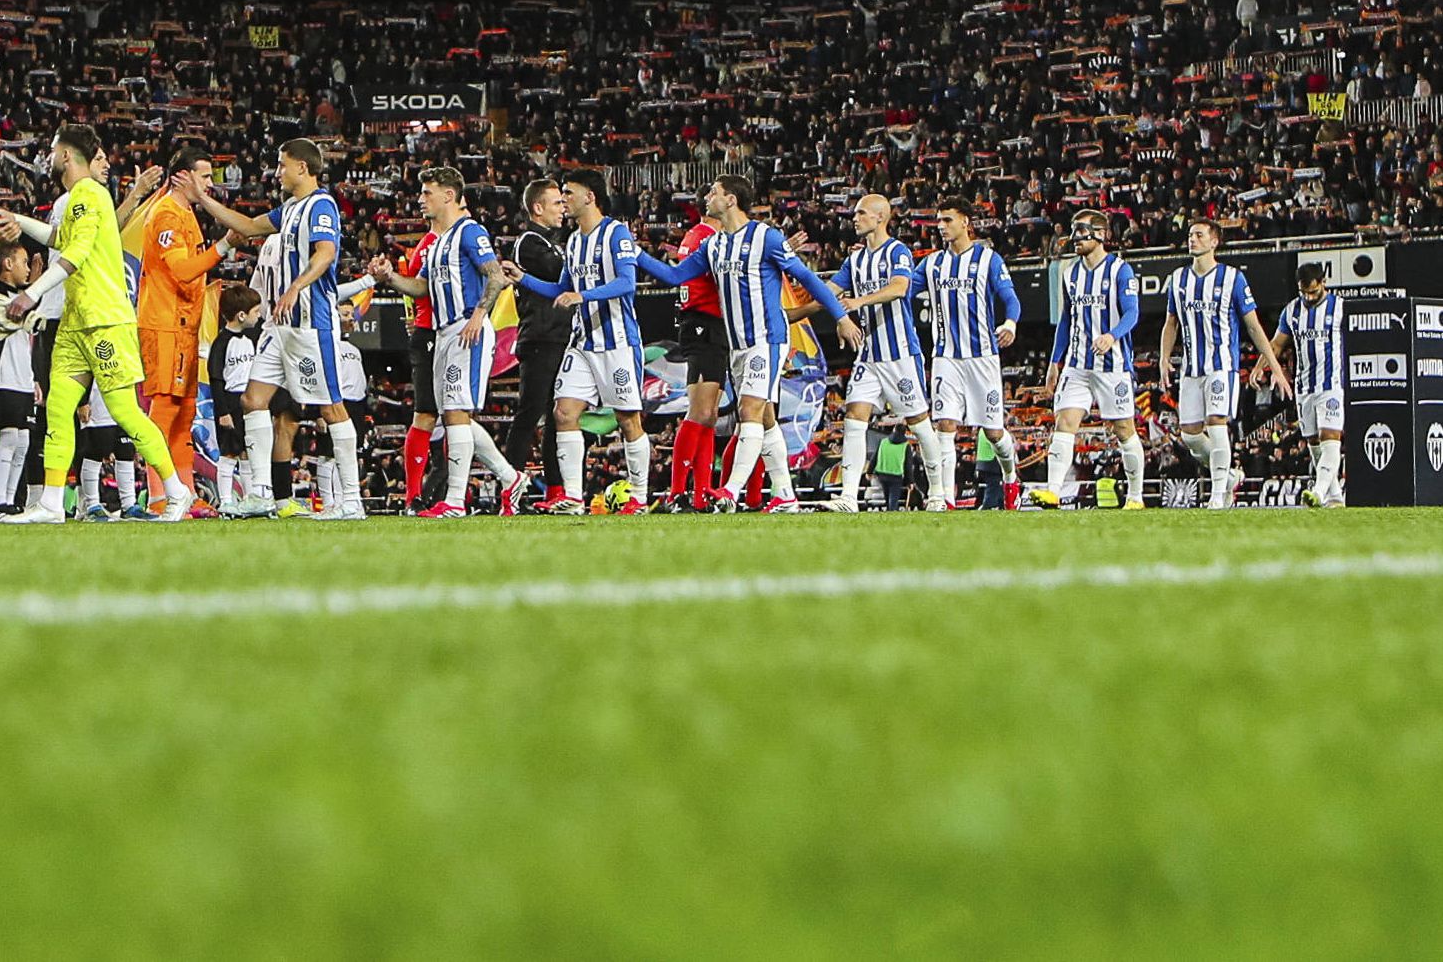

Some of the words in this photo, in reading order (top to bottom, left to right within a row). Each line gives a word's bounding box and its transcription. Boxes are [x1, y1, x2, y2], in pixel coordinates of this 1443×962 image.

[372, 94, 465, 110] SKODA
[1348, 313, 1390, 332] PUMA
[1419, 312, 1431, 324] TM
[1353, 361, 1373, 374] TM
[1417, 359, 1443, 377] PUMA
[299, 378, 318, 386] EMB
